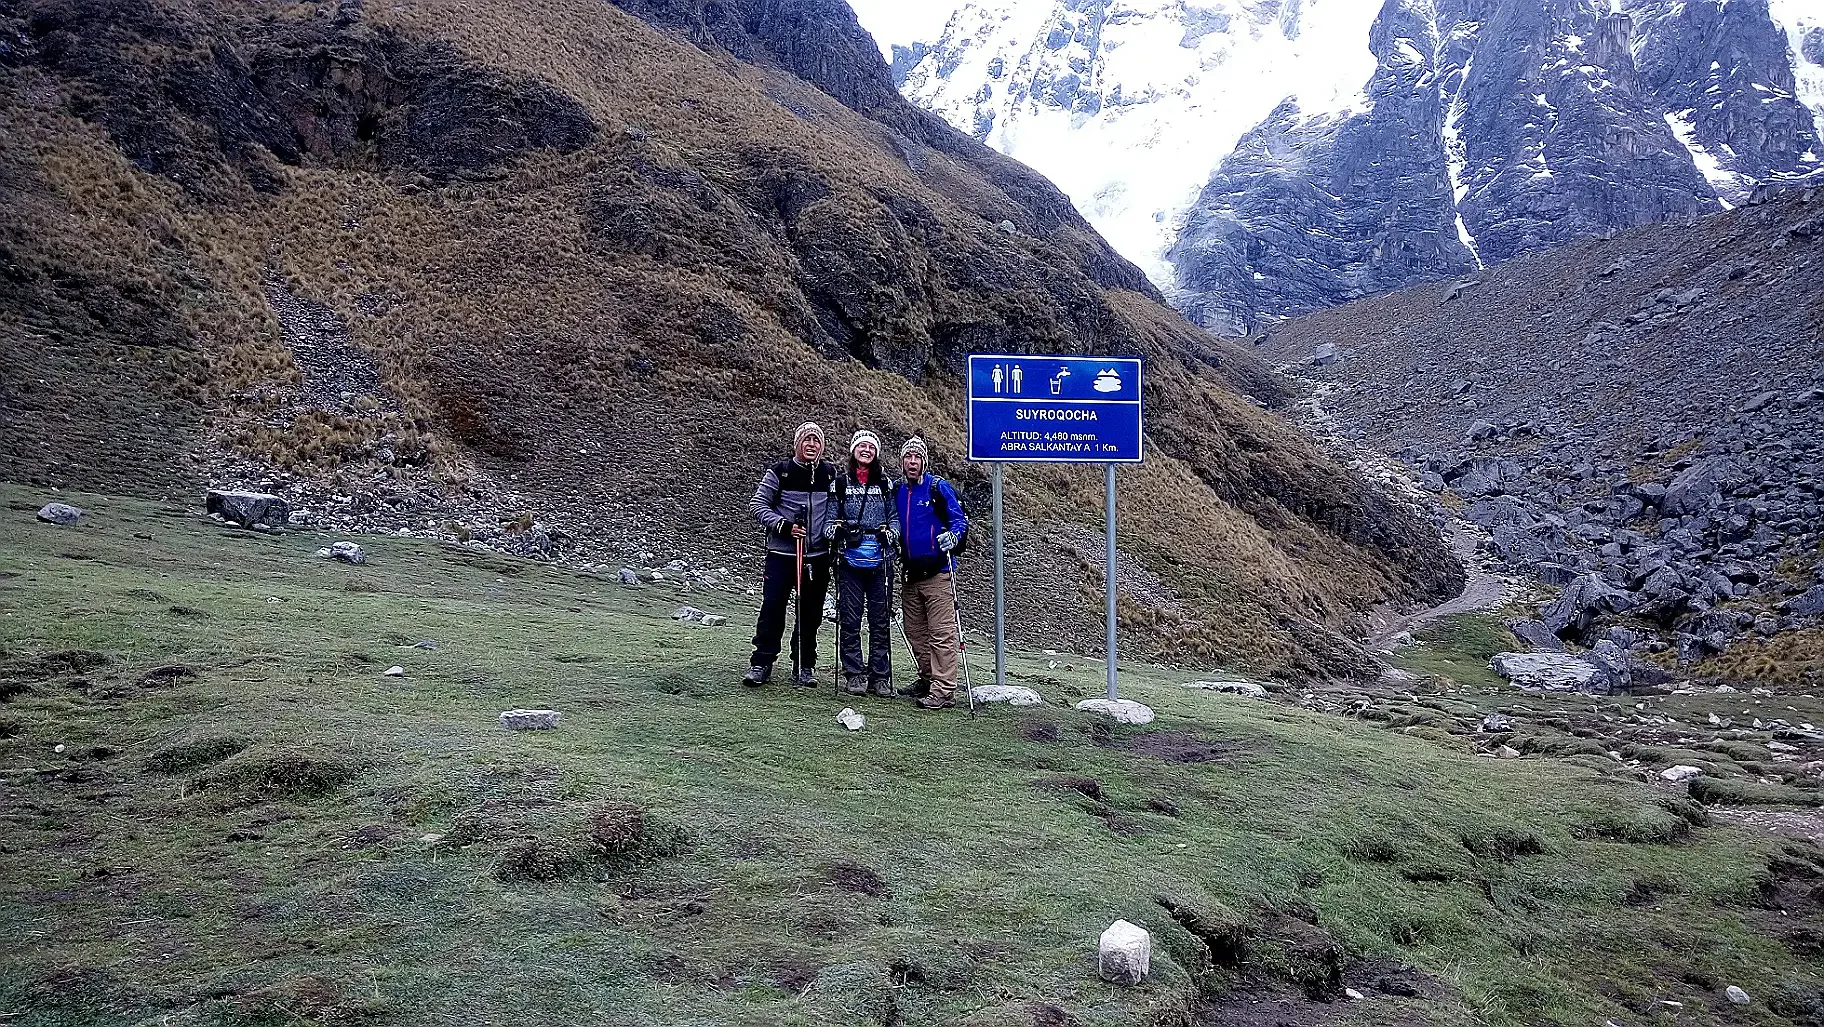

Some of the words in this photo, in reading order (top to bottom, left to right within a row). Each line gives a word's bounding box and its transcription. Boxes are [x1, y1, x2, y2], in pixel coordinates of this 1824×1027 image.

[1015, 408, 1098, 421] SUYROQOCHA
[1000, 431, 1042, 441] ALTITUD:
[1043, 431, 1069, 442] 4,480
[1070, 433, 1098, 441] msnm.
[1000, 442, 1028, 451] ABRA
[1095, 443, 1099, 452] 1
[1102, 443, 1119, 452] Km.
